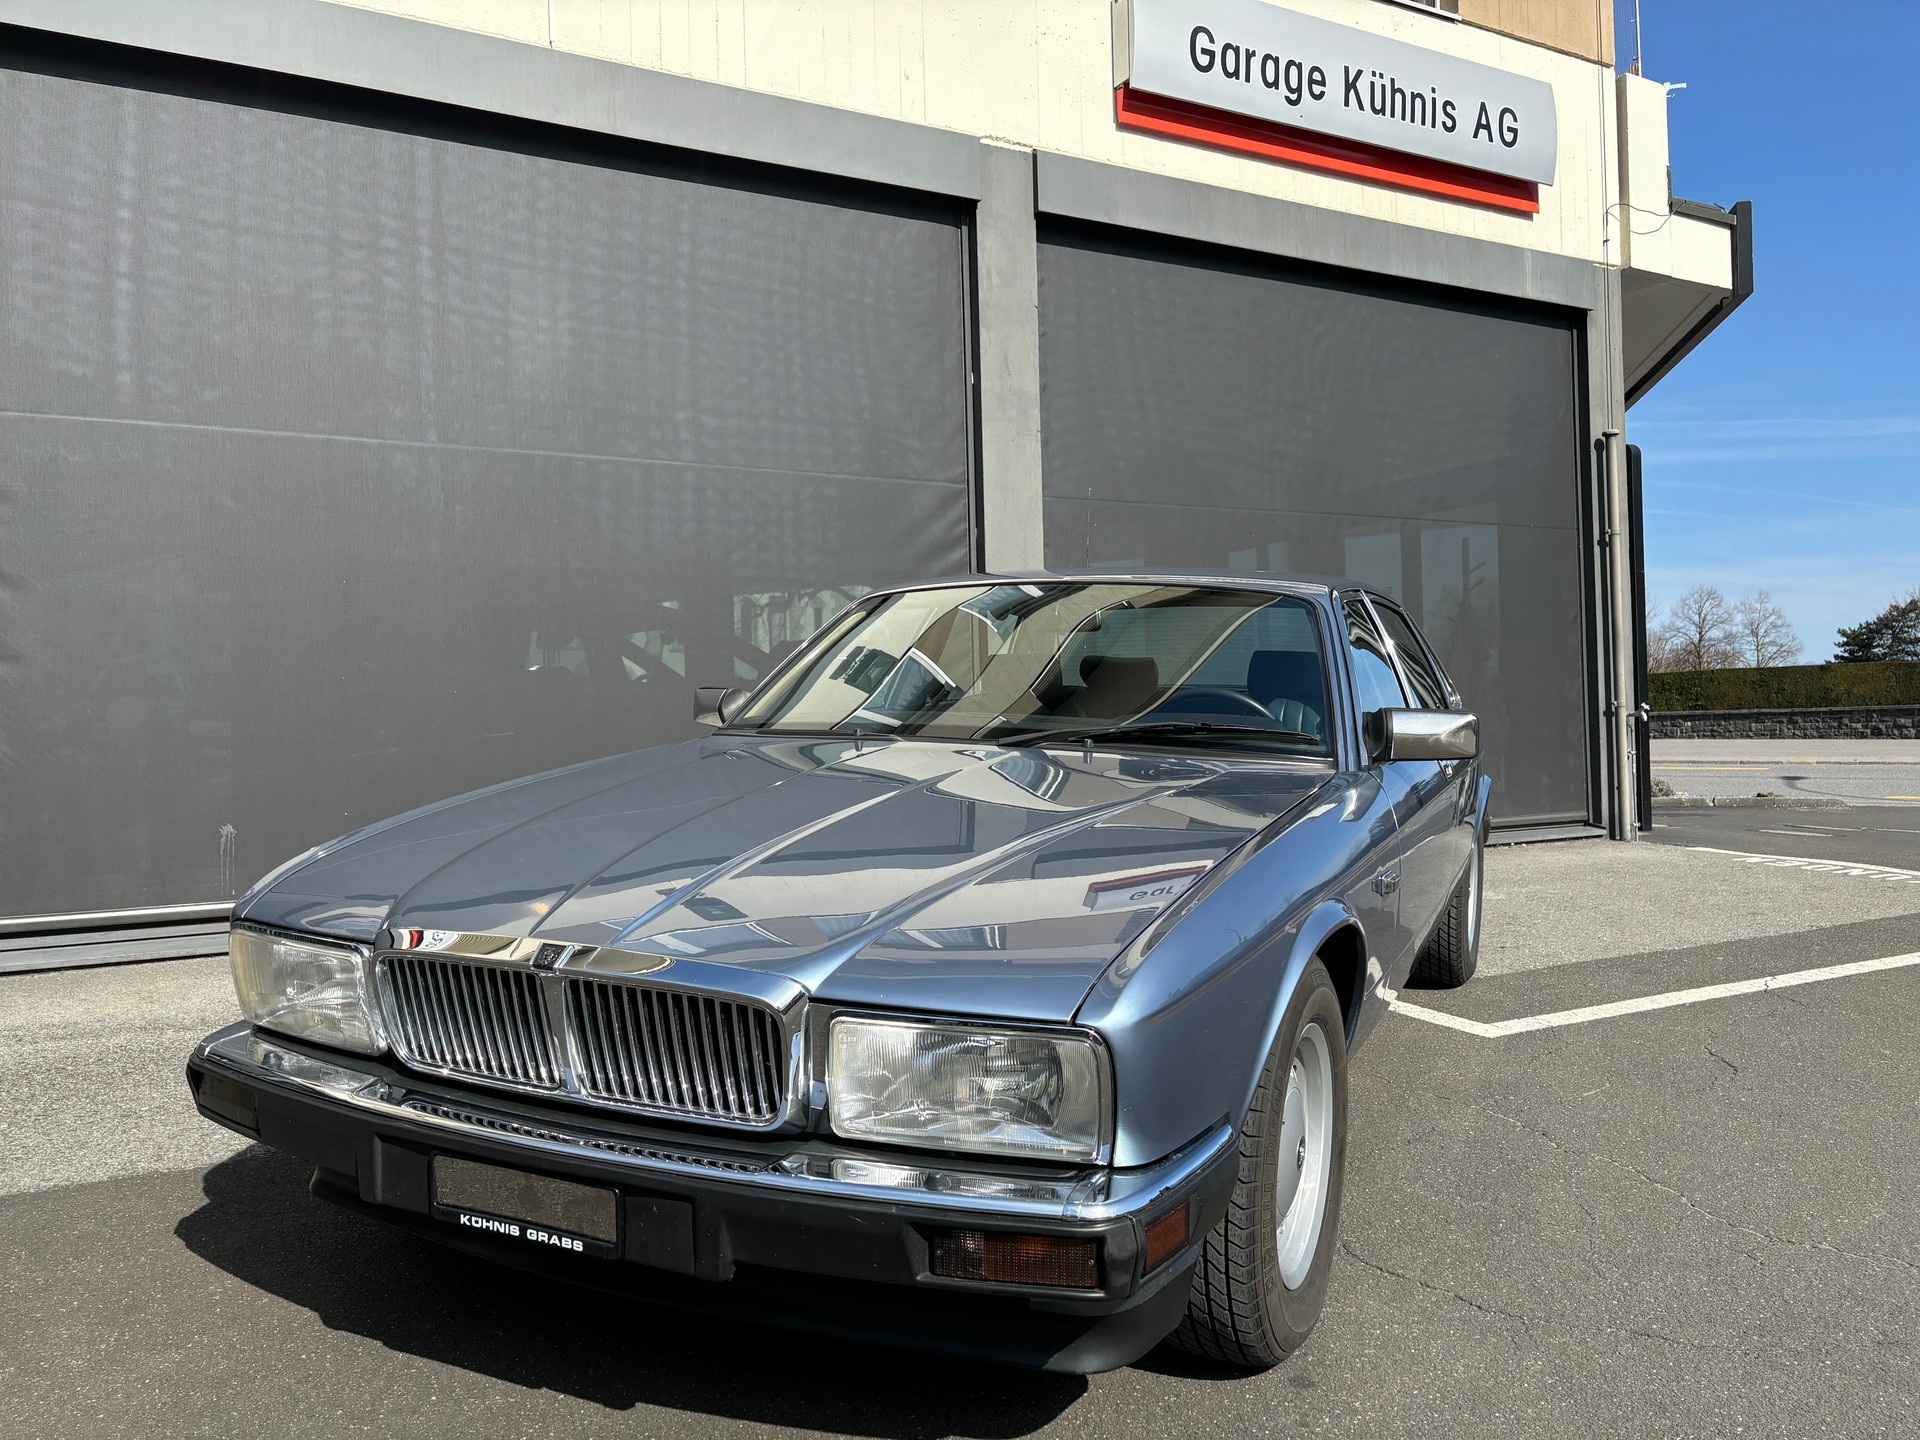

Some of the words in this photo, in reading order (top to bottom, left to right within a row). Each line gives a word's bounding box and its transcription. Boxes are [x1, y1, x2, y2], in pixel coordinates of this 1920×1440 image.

[1189, 26, 1327, 107] Garage
[1343, 65, 1458, 134] Kühnis
[1472, 101, 1519, 148] AG
[1732, 857, 1920, 883] UNDEN
[460, 1214, 520, 1237] KÜHNIS
[526, 1229, 584, 1252] GRABS
